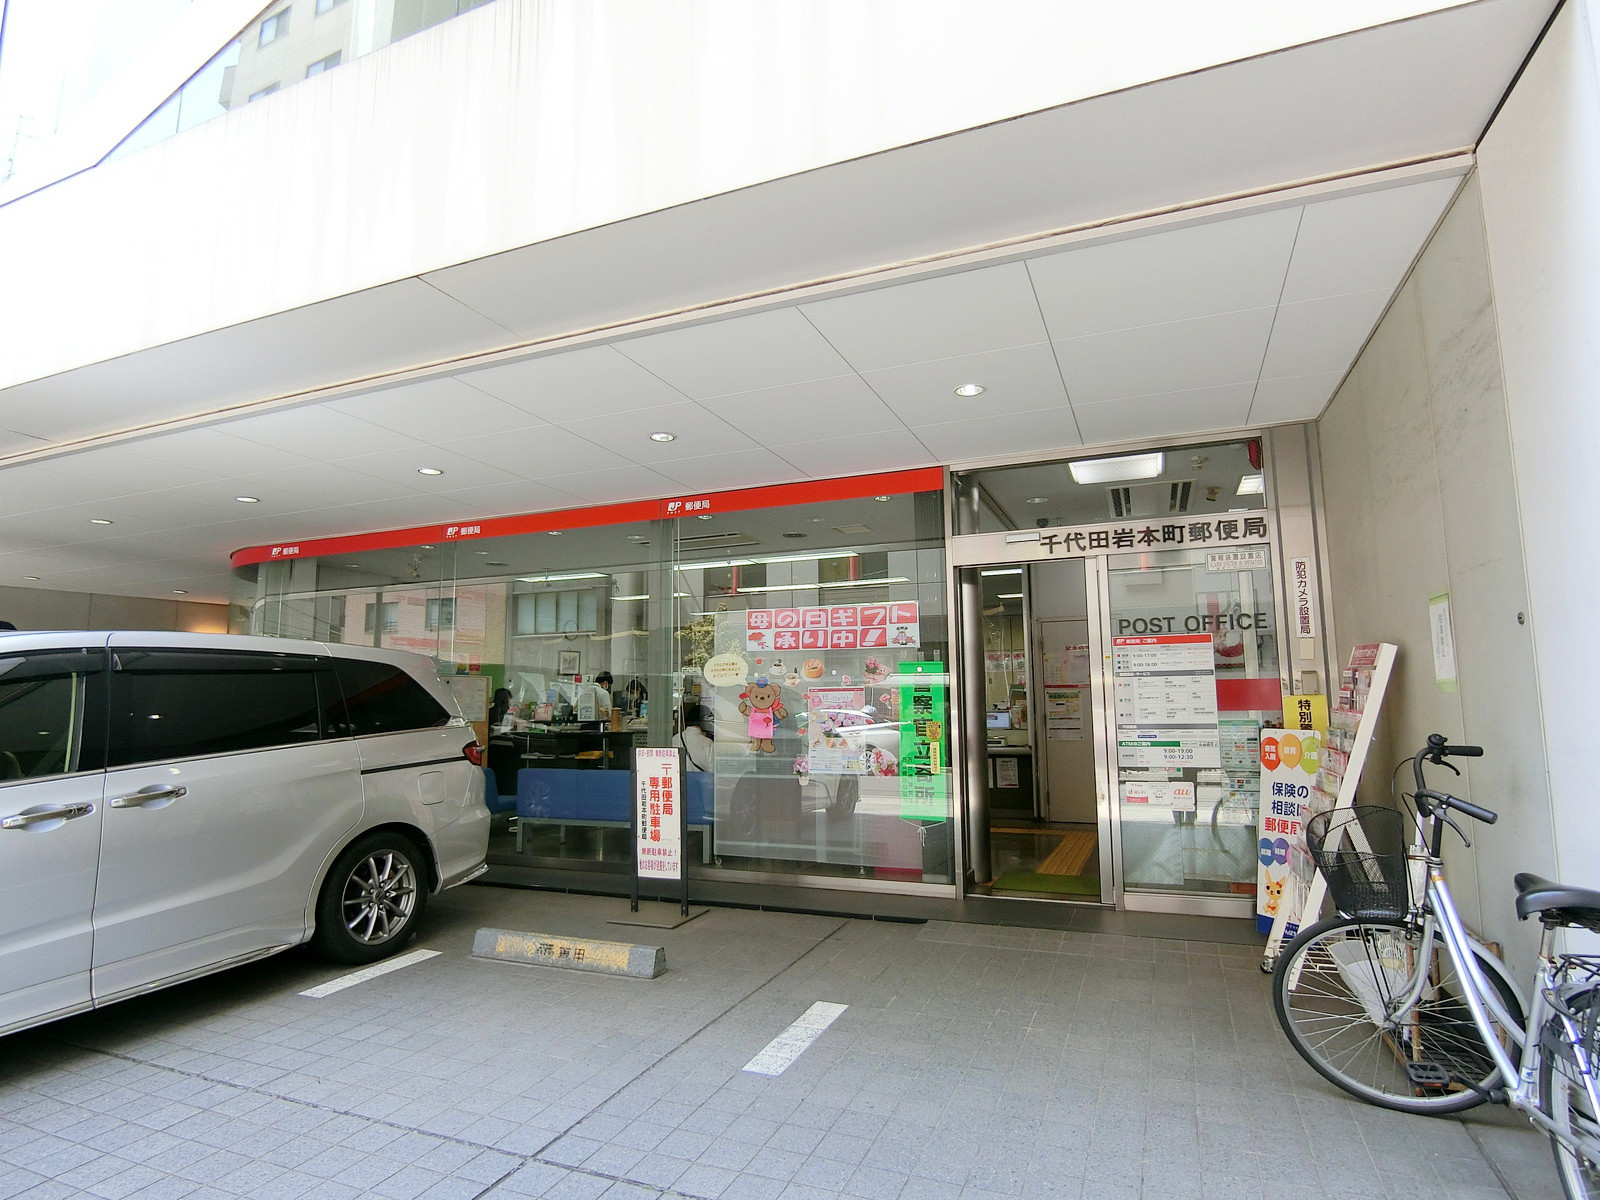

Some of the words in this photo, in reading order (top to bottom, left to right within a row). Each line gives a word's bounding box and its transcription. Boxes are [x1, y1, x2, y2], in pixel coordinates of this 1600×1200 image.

[685, 499, 710, 511] 郵便局
[460, 525, 480, 536] 郵便局
[1040, 516, 1267, 554] 千代田岩本町郵便局
[282, 546, 299, 555] 郵便局
[1295, 561, 1311, 635] 防犯カメラ設置局
[749, 605, 913, 629] 母の日ギフト
[1118, 616, 1176, 635] POST
[1184, 612, 1267, 633] OFFICE
[1173, 788, 1192, 796] au
[1272, 782, 1309, 799] 保険の
[649, 777, 661, 843] 専用駐車場
